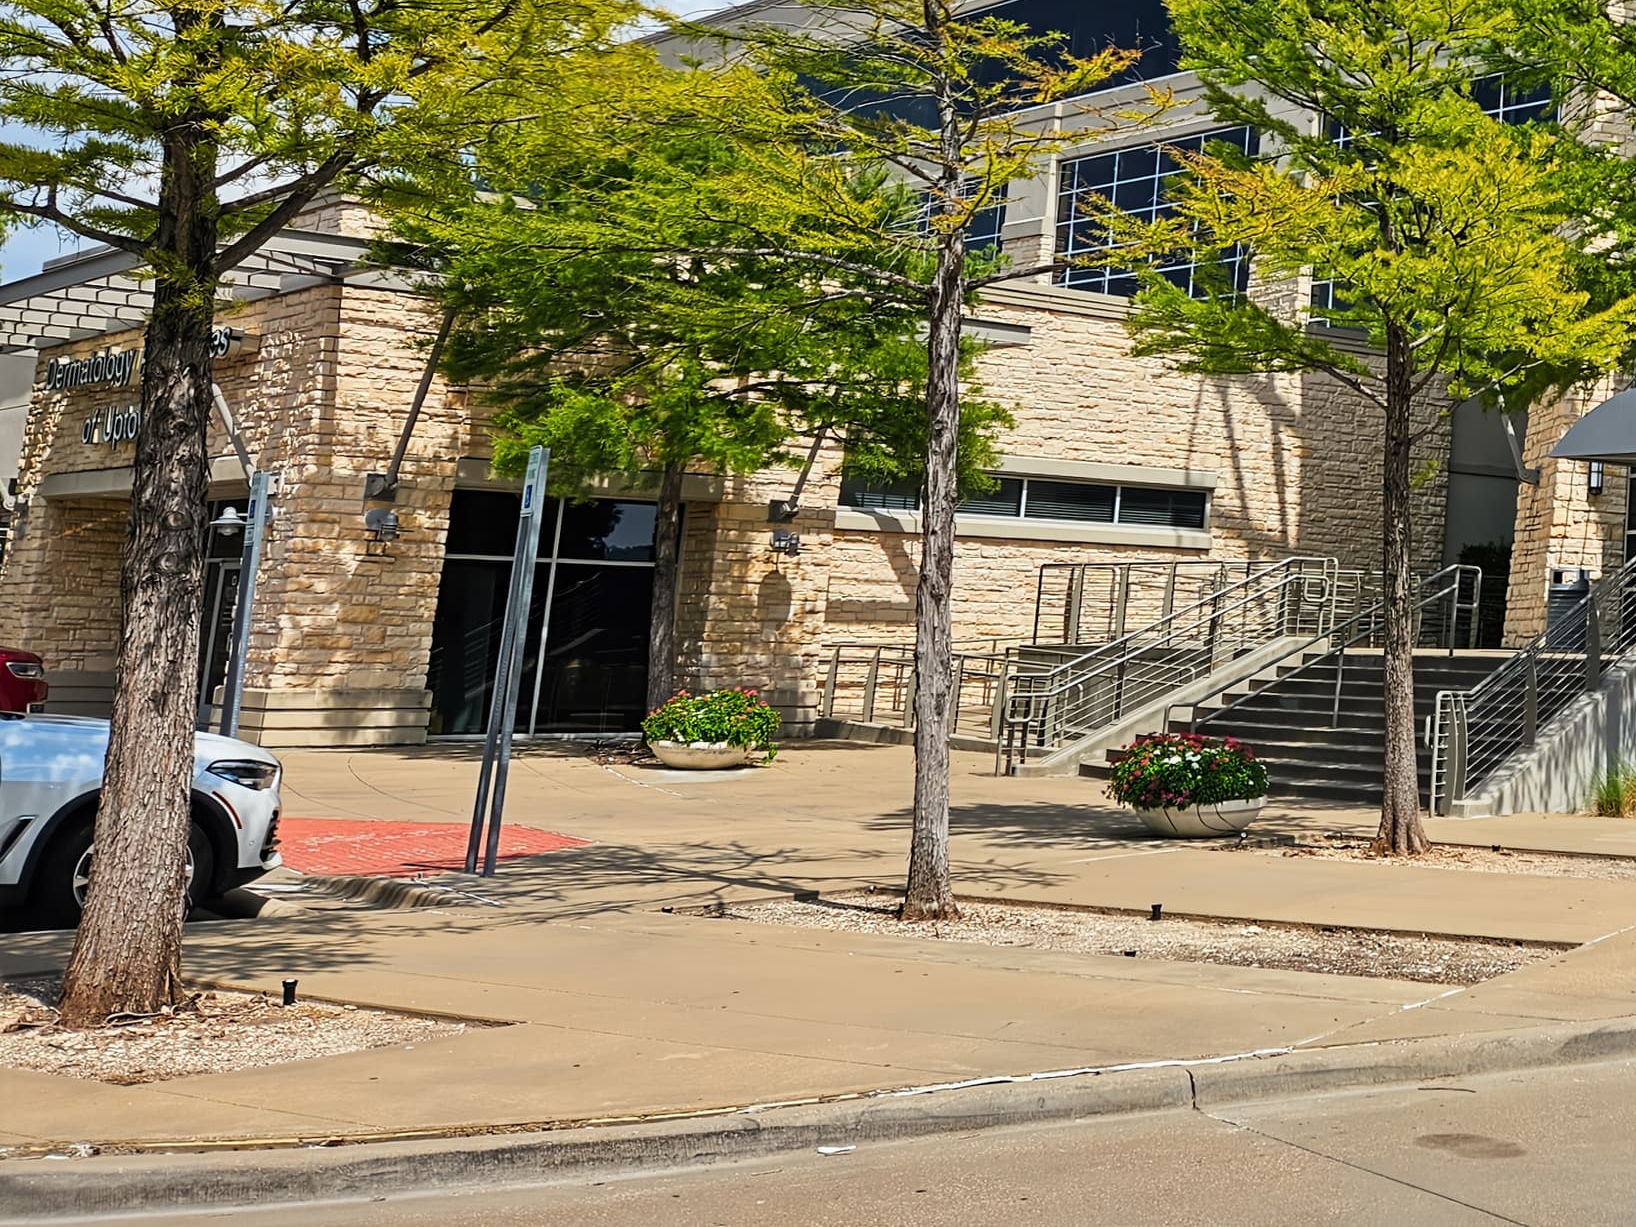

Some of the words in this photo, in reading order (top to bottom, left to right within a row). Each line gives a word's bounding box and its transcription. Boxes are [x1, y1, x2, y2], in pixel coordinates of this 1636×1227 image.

[46, 348, 135, 389] Dermatology
[81, 408, 101, 444] of
[102, 405, 142, 450] Upto
